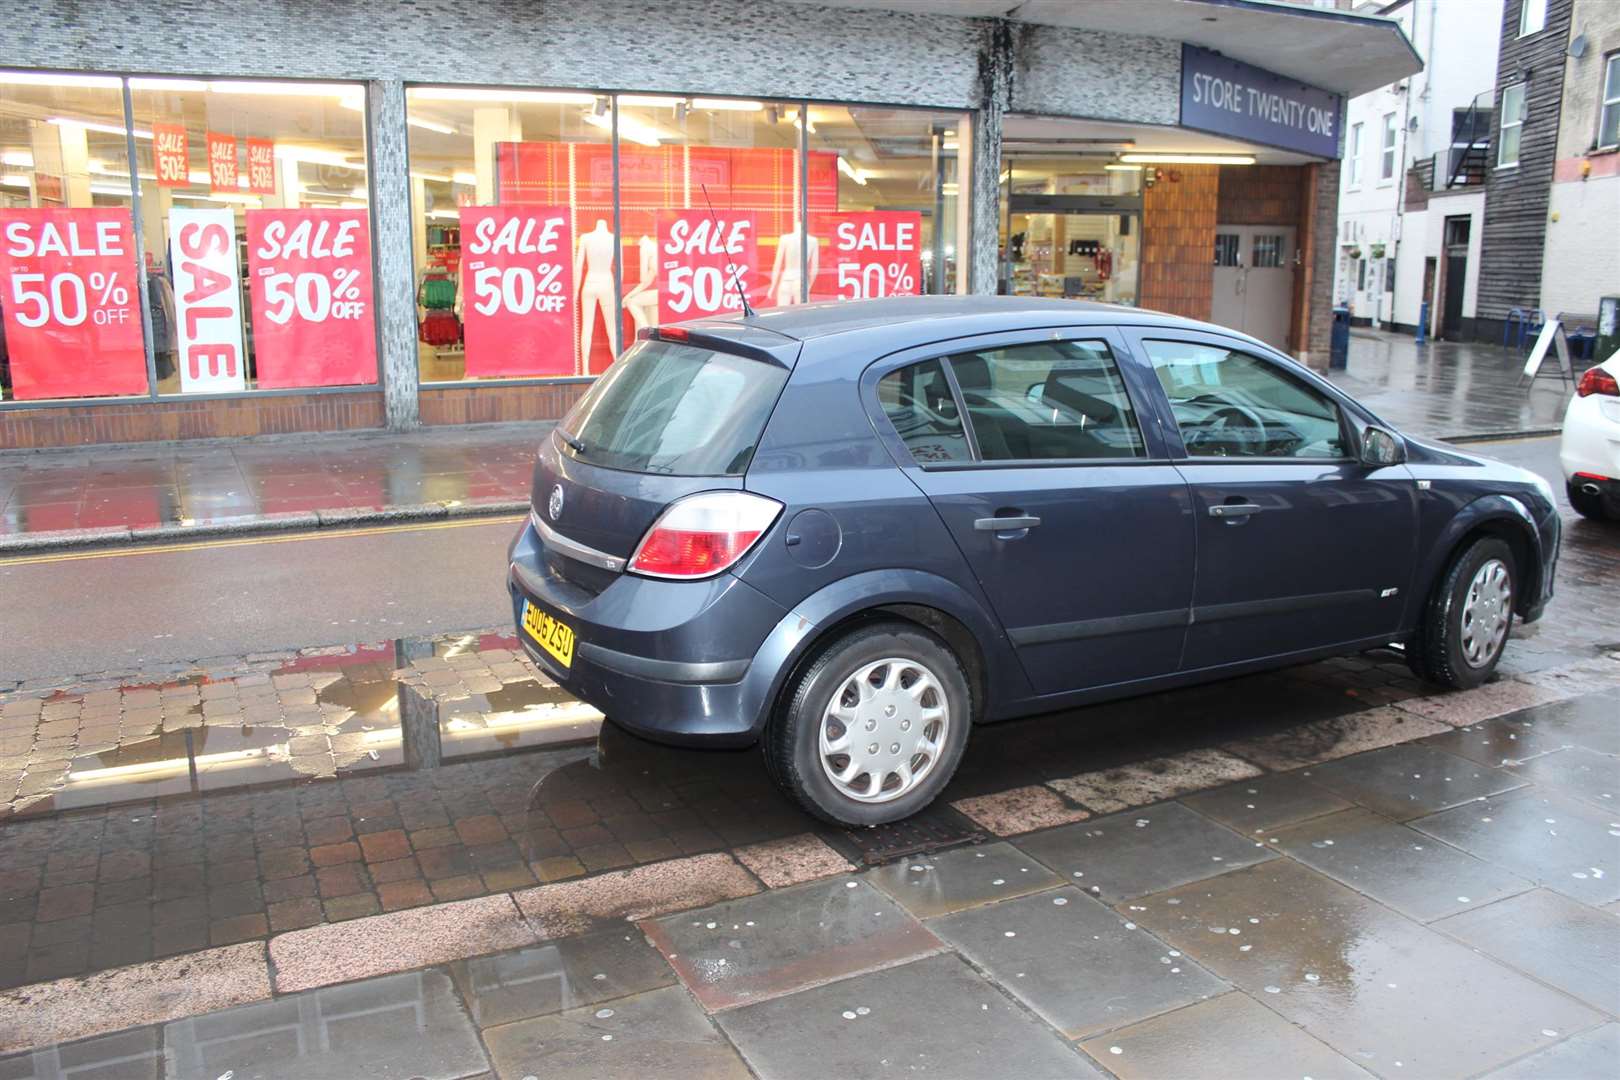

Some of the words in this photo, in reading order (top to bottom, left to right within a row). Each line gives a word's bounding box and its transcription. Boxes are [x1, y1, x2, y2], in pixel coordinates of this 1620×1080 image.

[1192, 72, 1243, 113] STORE
[1247, 88, 1306, 129] TWENTY
[1307, 107, 1334, 137] ONE
[158, 133, 185, 153] SALE
[211, 141, 234, 160] SALE
[251, 145, 272, 163] SALE
[6, 222, 125, 257] SALE
[257, 219, 361, 260] SALE
[469, 217, 565, 254] SALE
[664, 219, 751, 255] SALE
[837, 222, 915, 251] SALE
[11, 272, 129, 328] 50%
[94, 308, 129, 325] OFF
[179, 222, 237, 380] SALE
[264, 268, 361, 325] 50%
[331, 301, 366, 320] OFF
[474, 263, 563, 316] 50%
[535, 294, 567, 312] OFF
[549, 620, 573, 657] ZSU
